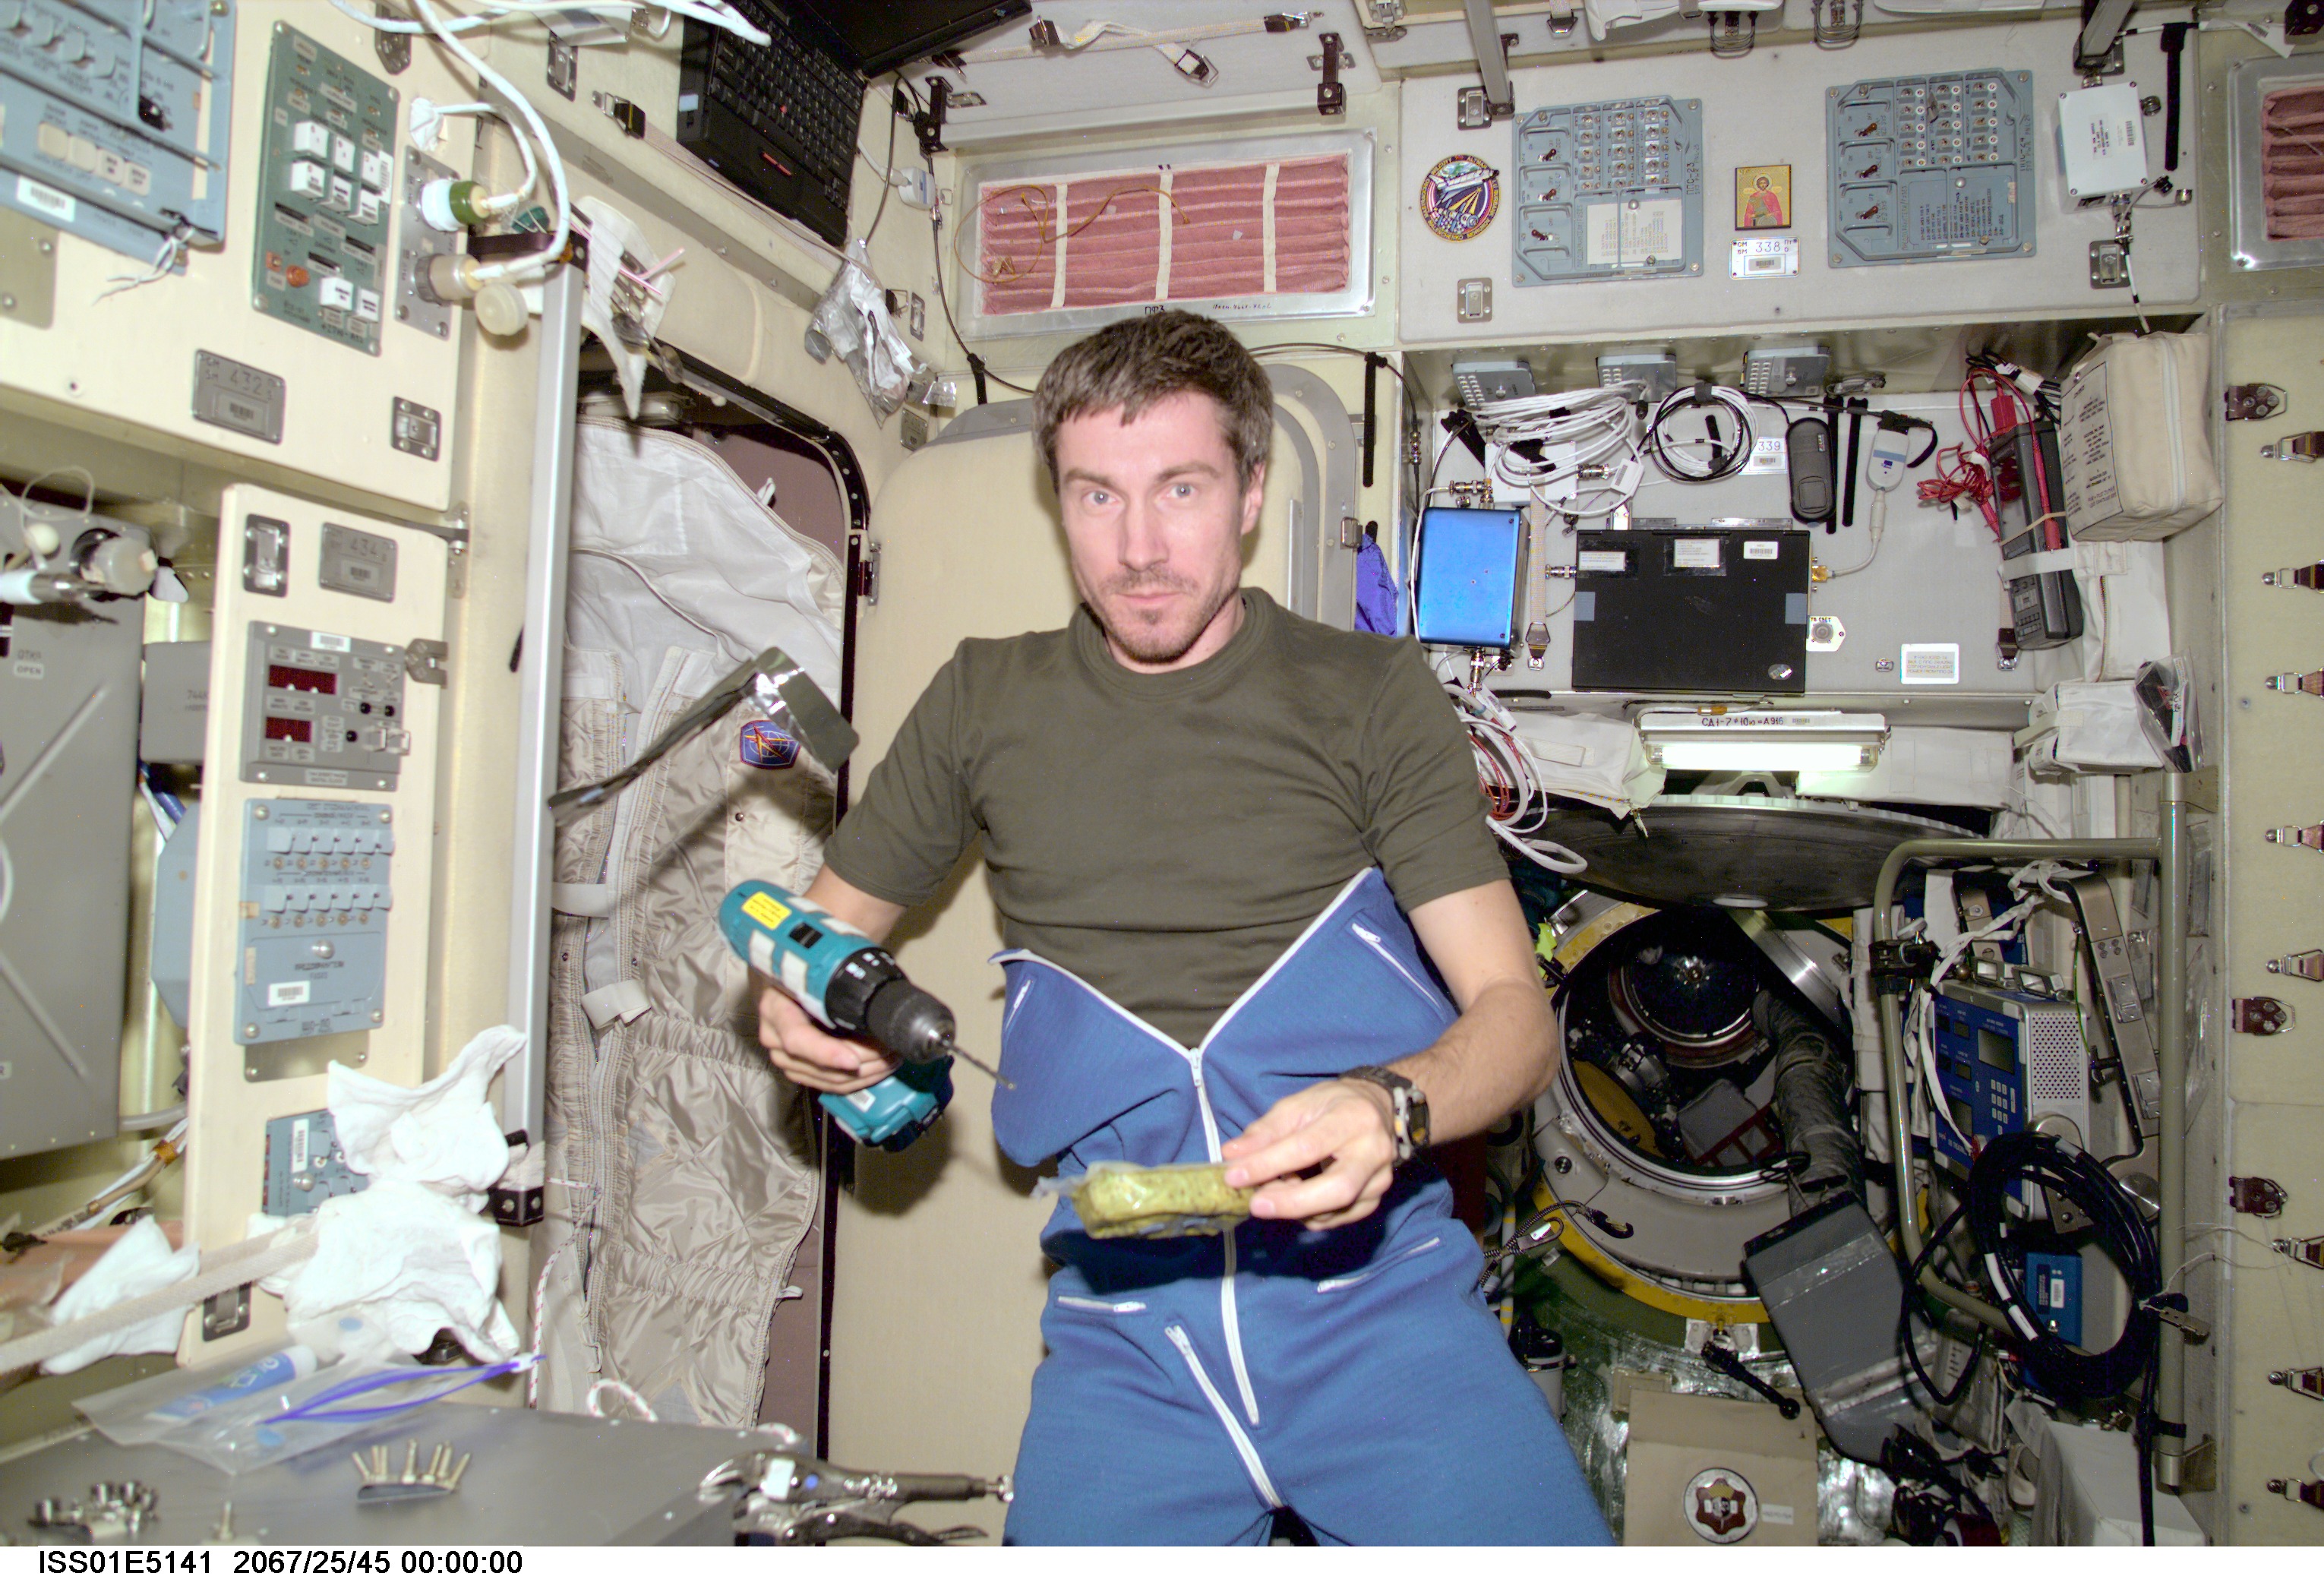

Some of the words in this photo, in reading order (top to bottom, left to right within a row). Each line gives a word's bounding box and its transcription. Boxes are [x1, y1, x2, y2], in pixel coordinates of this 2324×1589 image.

[1756, 242, 1781, 253] 338
[1758, 441, 1781, 451] 339
[17, 665, 42, 674] OPEN
